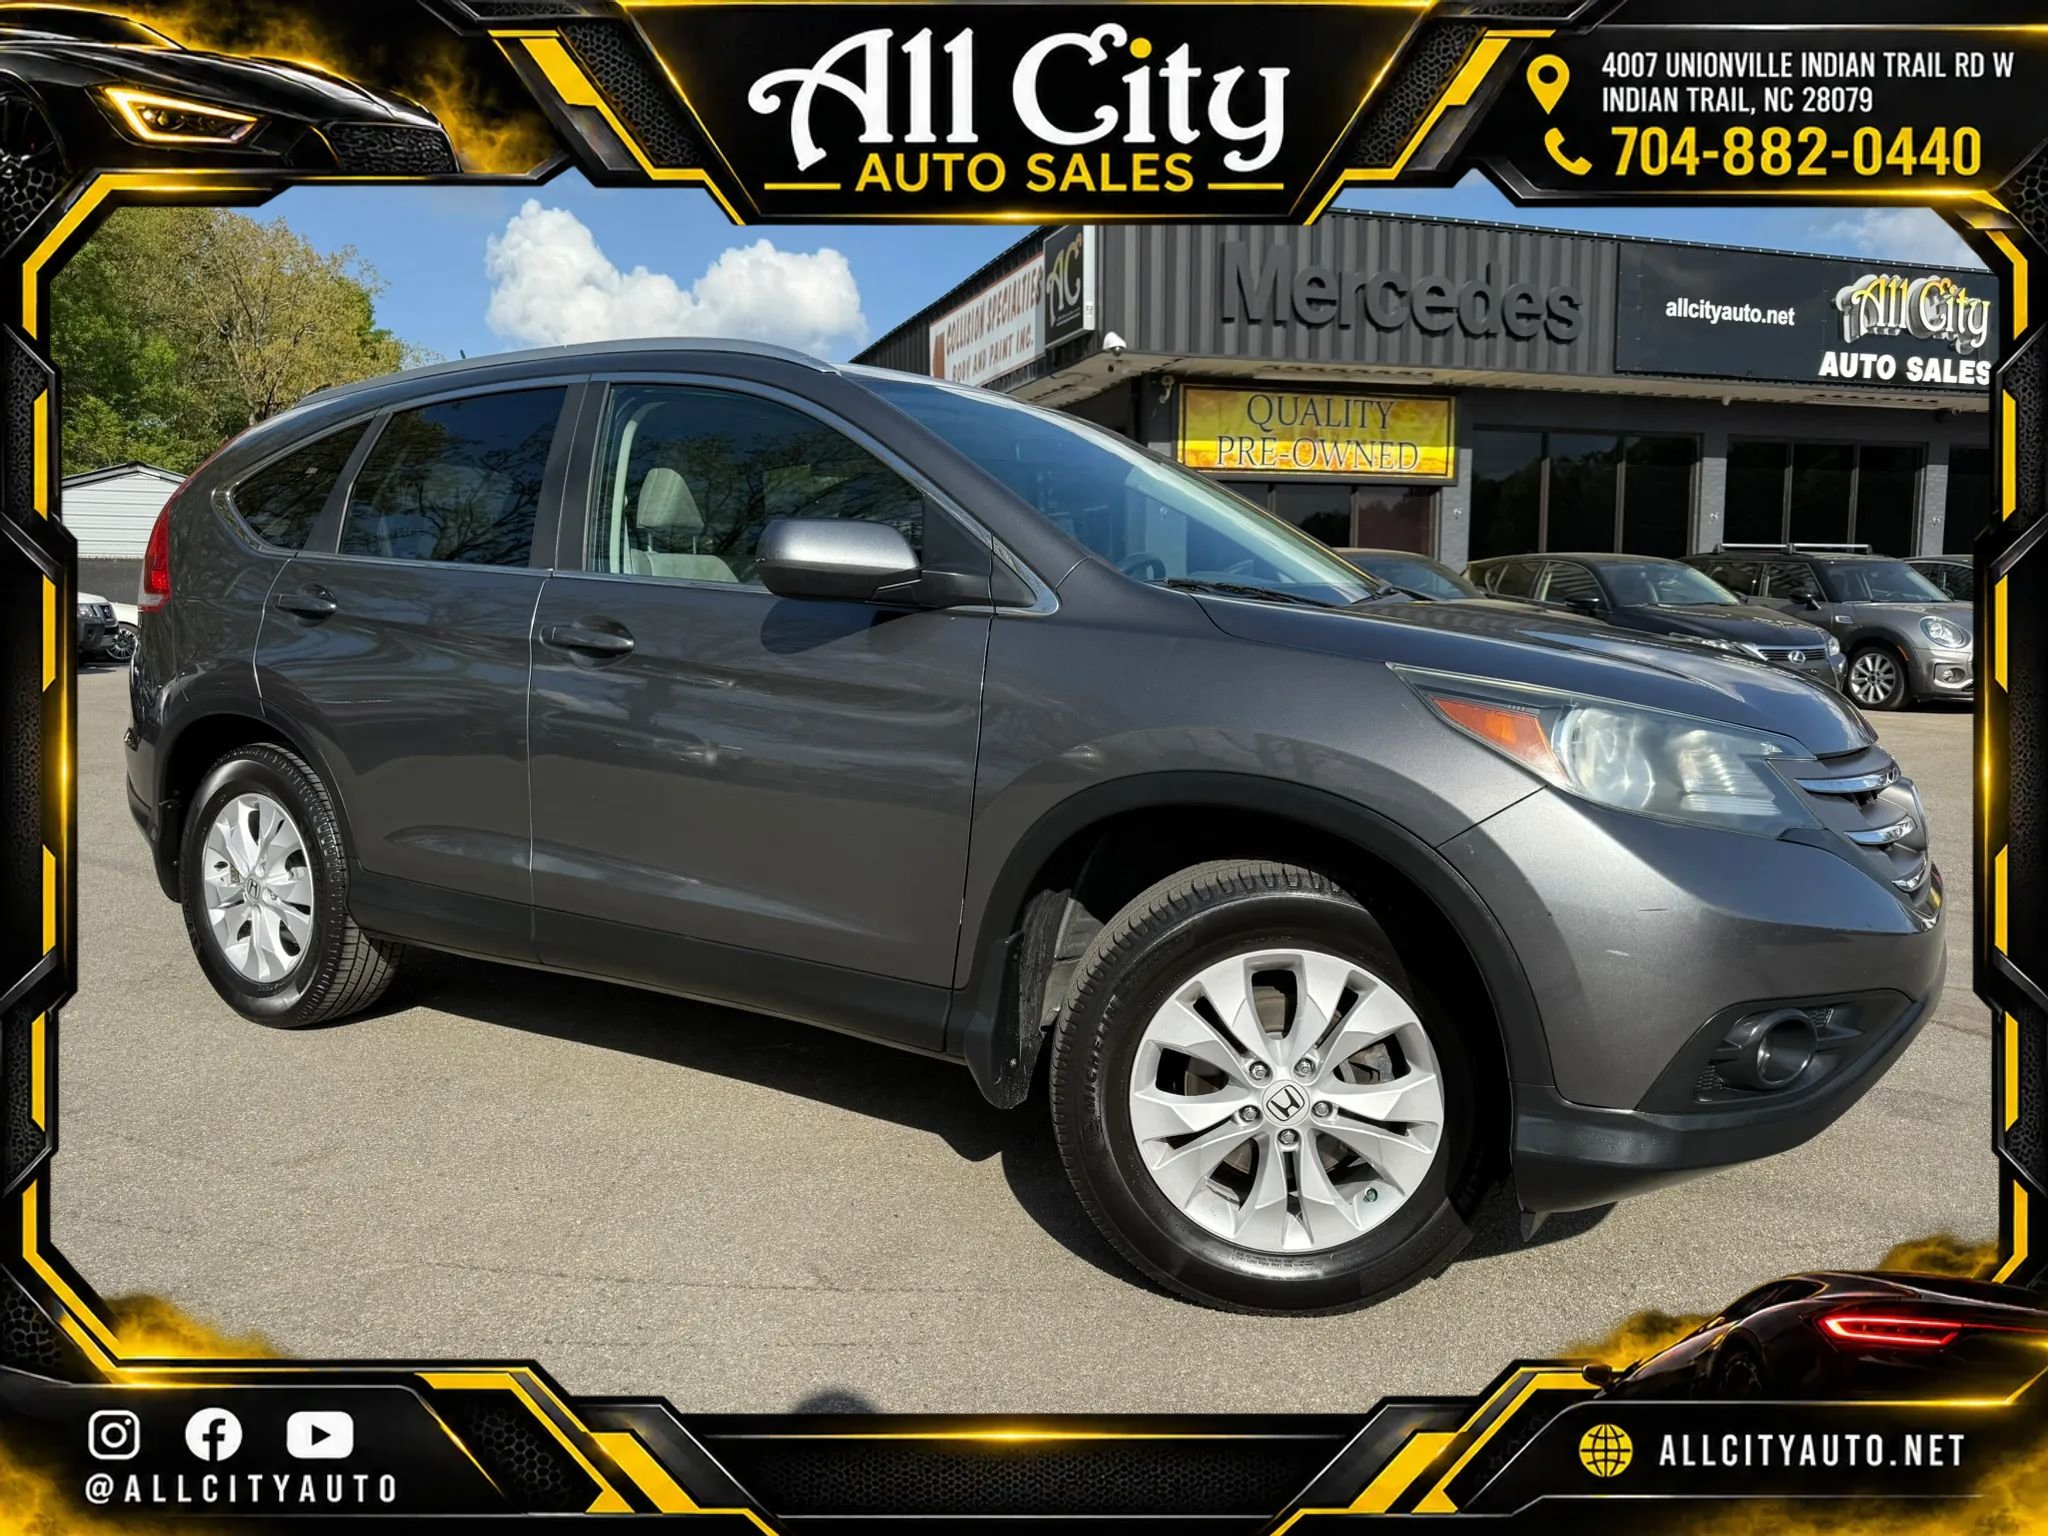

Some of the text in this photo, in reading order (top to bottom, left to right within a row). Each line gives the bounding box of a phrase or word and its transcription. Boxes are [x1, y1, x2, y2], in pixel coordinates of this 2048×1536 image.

[946, 264, 1043, 356] COLLISION SPECIALTIES
[1221, 240, 1586, 345] Mercedes
[1665, 297, 1796, 326] allcityauto.net
[1846, 274, 1990, 352] All City
[972, 348, 987, 377] AND
[988, 332, 1014, 368] PAINT
[1818, 351, 1990, 386] AUTO SALES
[1246, 393, 1396, 431] QUALITY
[1215, 434, 1419, 472] PRE-OWNED
